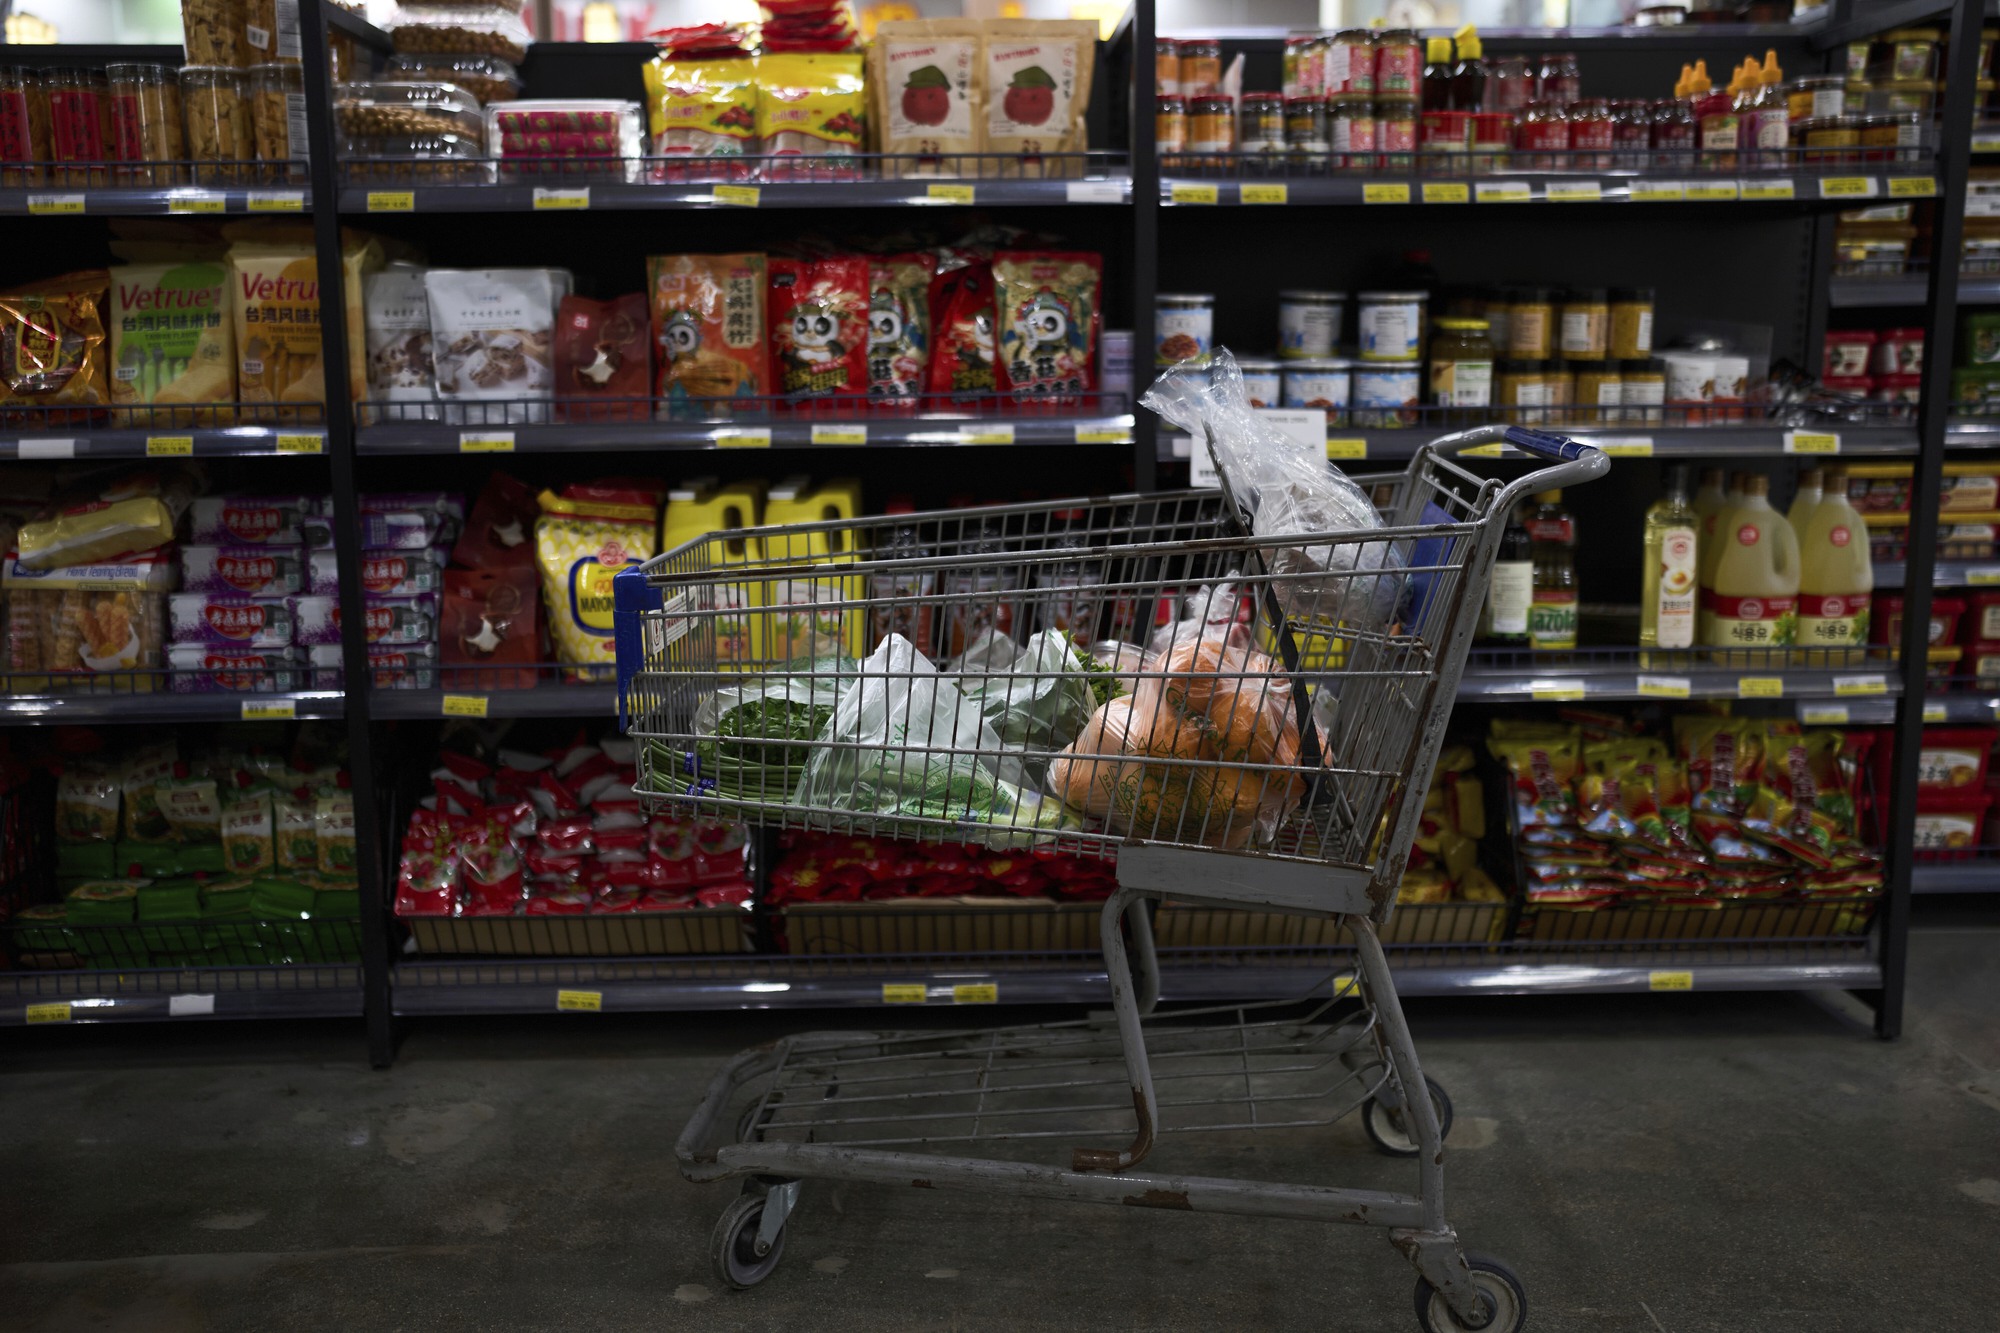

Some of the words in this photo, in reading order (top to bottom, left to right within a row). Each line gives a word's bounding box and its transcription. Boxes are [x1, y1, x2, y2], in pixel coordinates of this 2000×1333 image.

[241, 272, 321, 301] Vetru
[120, 284, 210, 311] Vetrue
[121, 313, 221, 332] 台湾风味米饼
[87, 502, 98, 513] 10
[66, 567, 88, 577] Hand
[89, 566, 114, 581] Tearing
[115, 565, 138, 578] Bread
[1731, 626, 1768, 642] 식용유
[1814, 624, 1849, 640] 식용유
